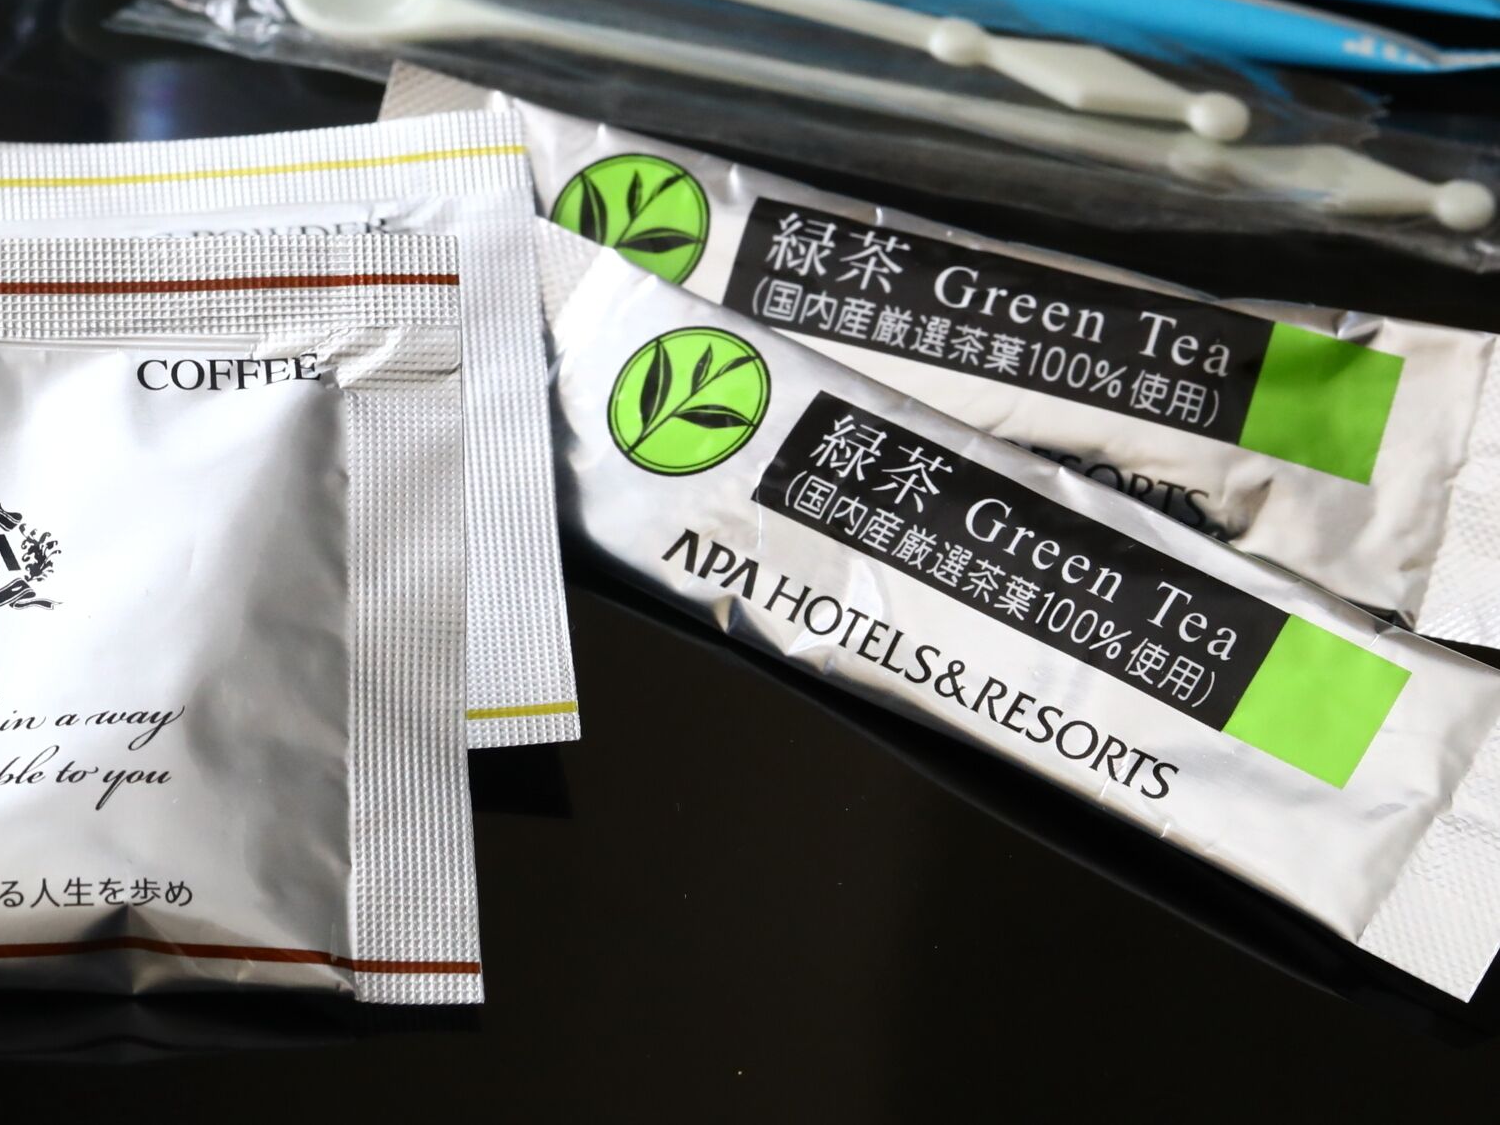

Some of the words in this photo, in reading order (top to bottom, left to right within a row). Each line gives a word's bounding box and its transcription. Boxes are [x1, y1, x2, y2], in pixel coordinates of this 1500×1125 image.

[765, 212, 911, 293] 緑茶
[933, 265, 1105, 343] Green
[1137, 311, 1230, 378] Tea
[137, 353, 322, 391] COFFEE
[809, 414, 954, 513] 緑茶
[964, 497, 1125, 603] Green
[1147, 582, 1237, 663] Tea
[0, 709, 47, 732] in
[54, 712, 80, 727] a
[85, 705, 186, 751] way
[55, 762, 99, 785] to
[95, 766, 172, 811] you
